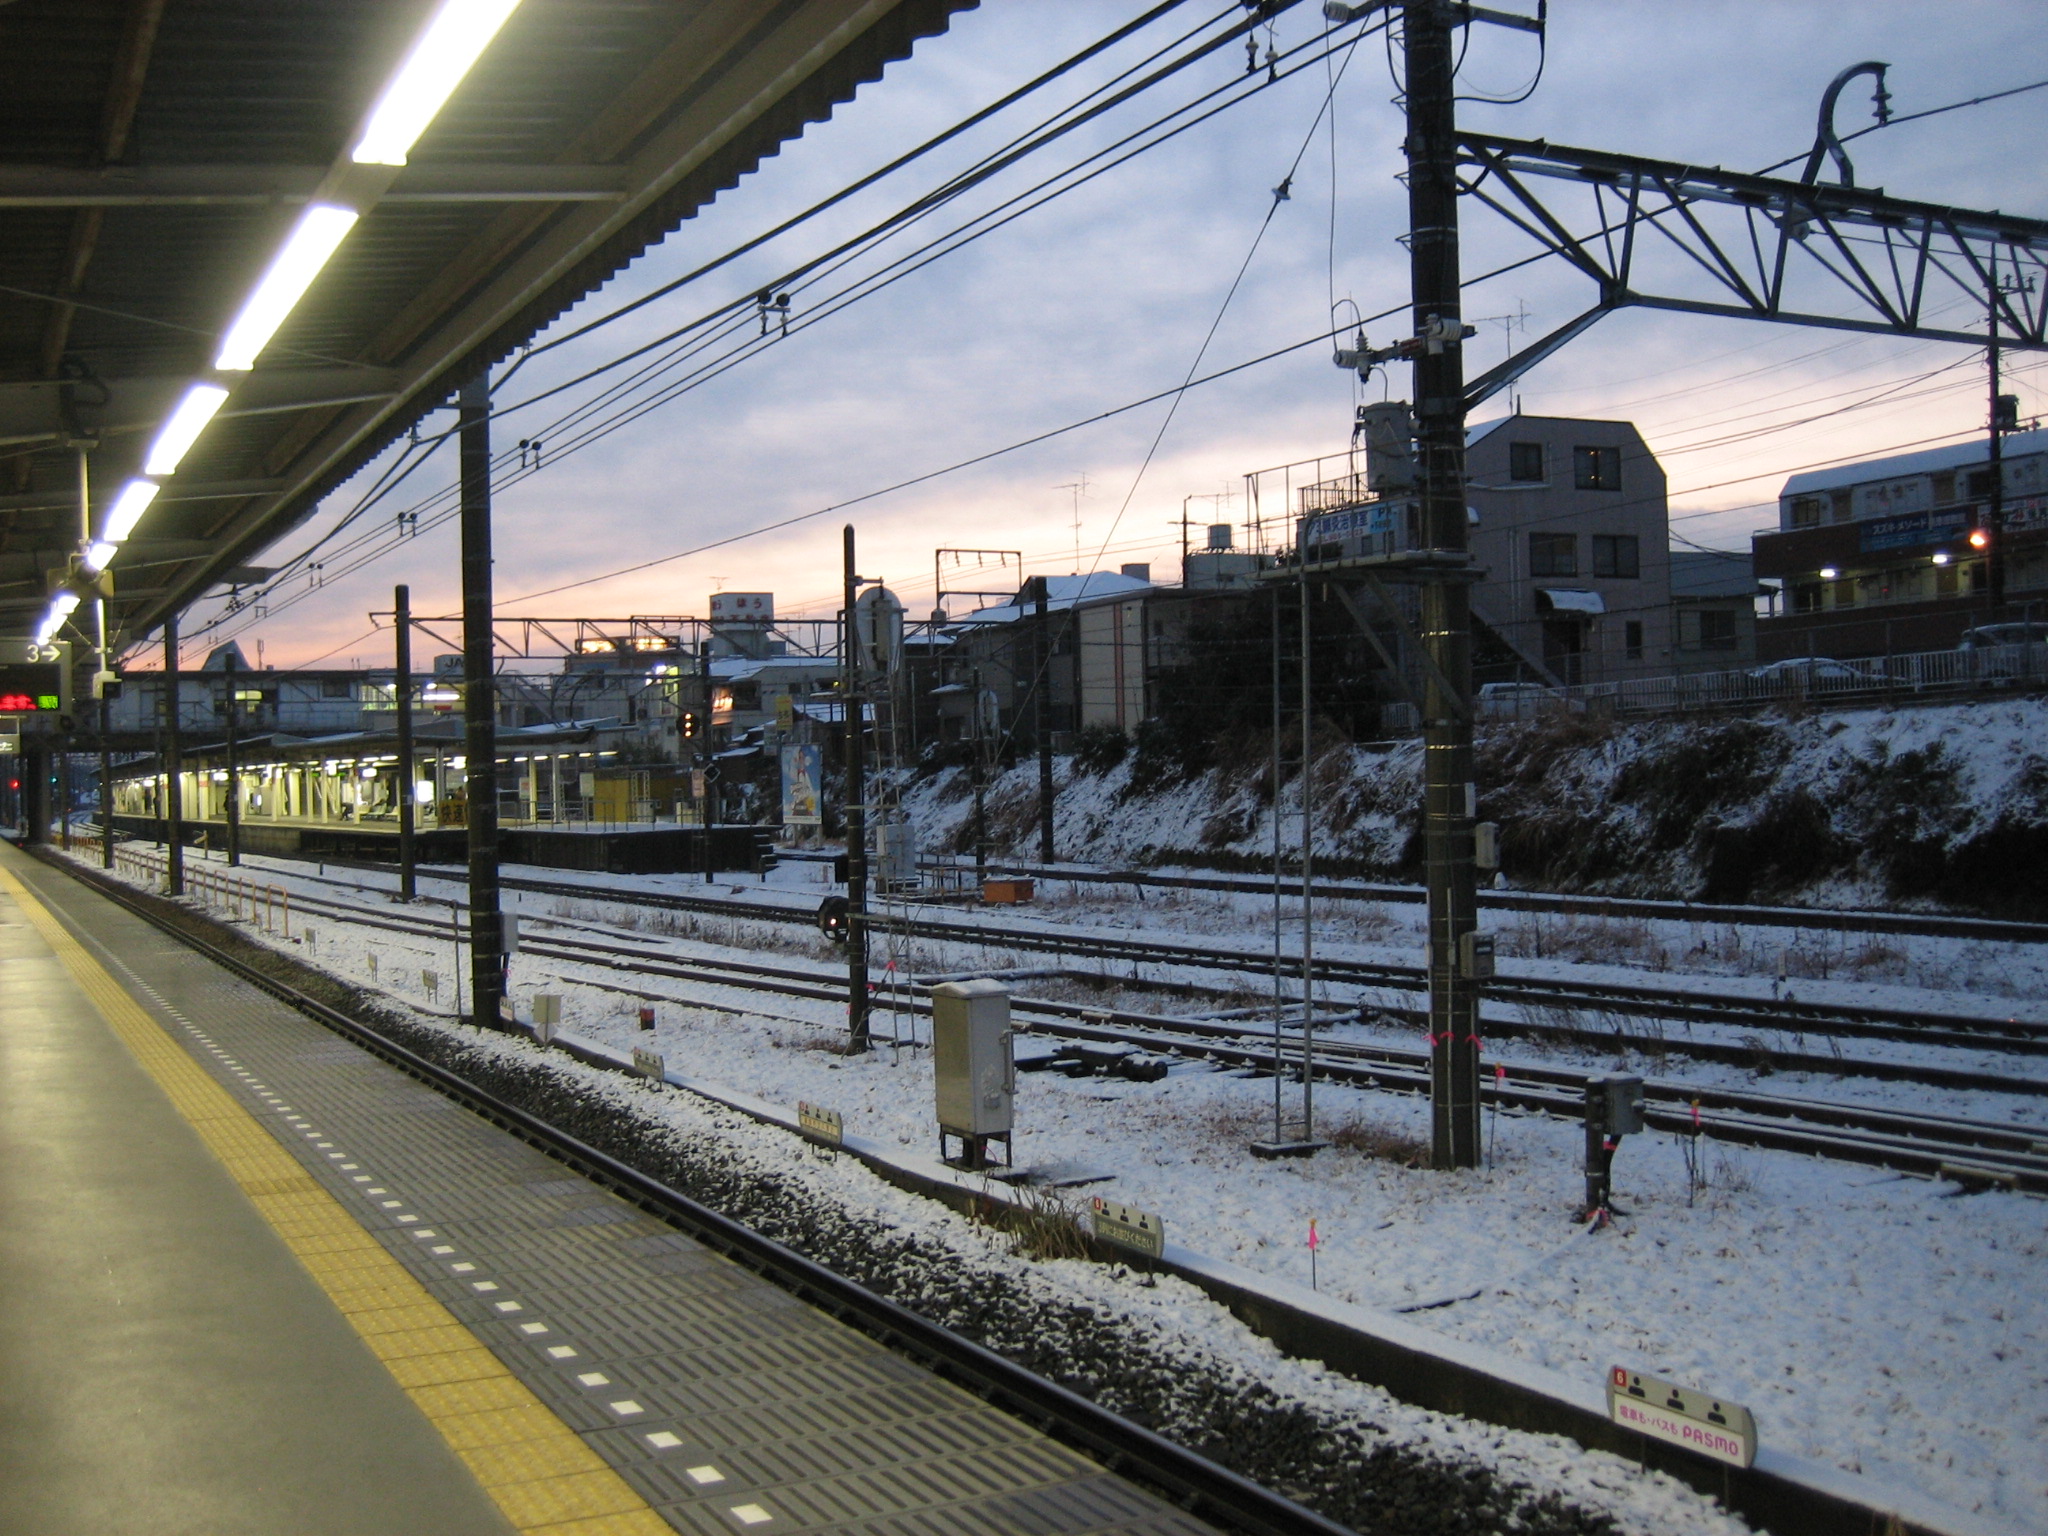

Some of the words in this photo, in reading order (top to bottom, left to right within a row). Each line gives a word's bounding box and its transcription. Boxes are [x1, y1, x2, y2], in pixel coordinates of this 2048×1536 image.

[27, 644, 39, 663] 3
[1616, 1371, 1624, 1384] 6
[1682, 1425, 1739, 1457] PASMO
